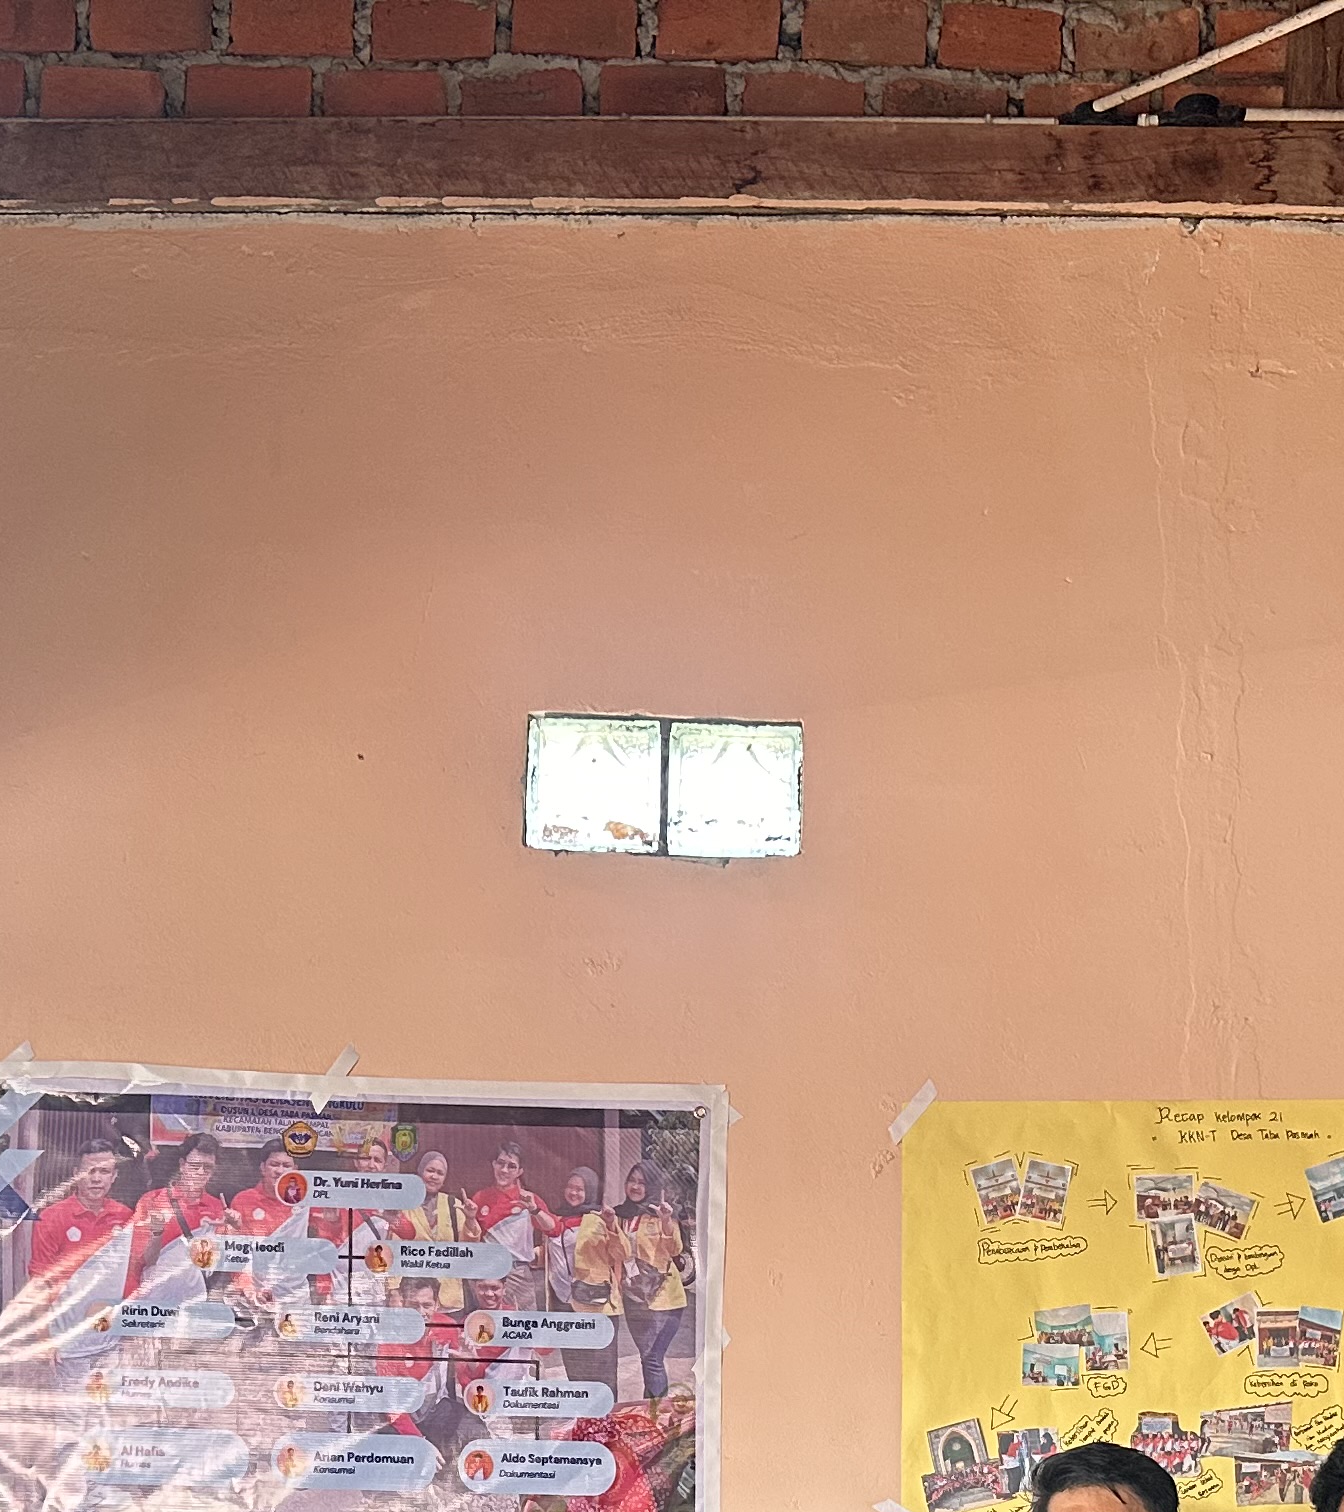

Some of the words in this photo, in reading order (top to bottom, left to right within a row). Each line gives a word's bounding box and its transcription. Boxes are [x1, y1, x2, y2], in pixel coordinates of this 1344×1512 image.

[1269, 1112, 1283, 1123] 21
[1230, 1130, 1253, 1141] Desa
[313, 1176, 331, 1187] Dr.
[332, 1176, 359, 1188] Yuni
[313, 1190, 330, 1199] DPL
[400, 1245, 426, 1257] Rico
[428, 1246, 474, 1259] Fadillah
[425, 1260, 451, 1270] Ketua
[121, 1304, 148, 1316] Ririn
[502, 1316, 538, 1331] Bunga
[502, 1331, 533, 1340] ACARA
[1094, 1379, 1119, 1392] FGD
[503, 1386, 539, 1398] Taufik
[541, 1387, 589, 1399] Rahman
[503, 1400, 561, 1410] Dokumentasi
[501, 1452, 526, 1464] Aldo
[499, 1469, 556, 1479] Dokumentasi
